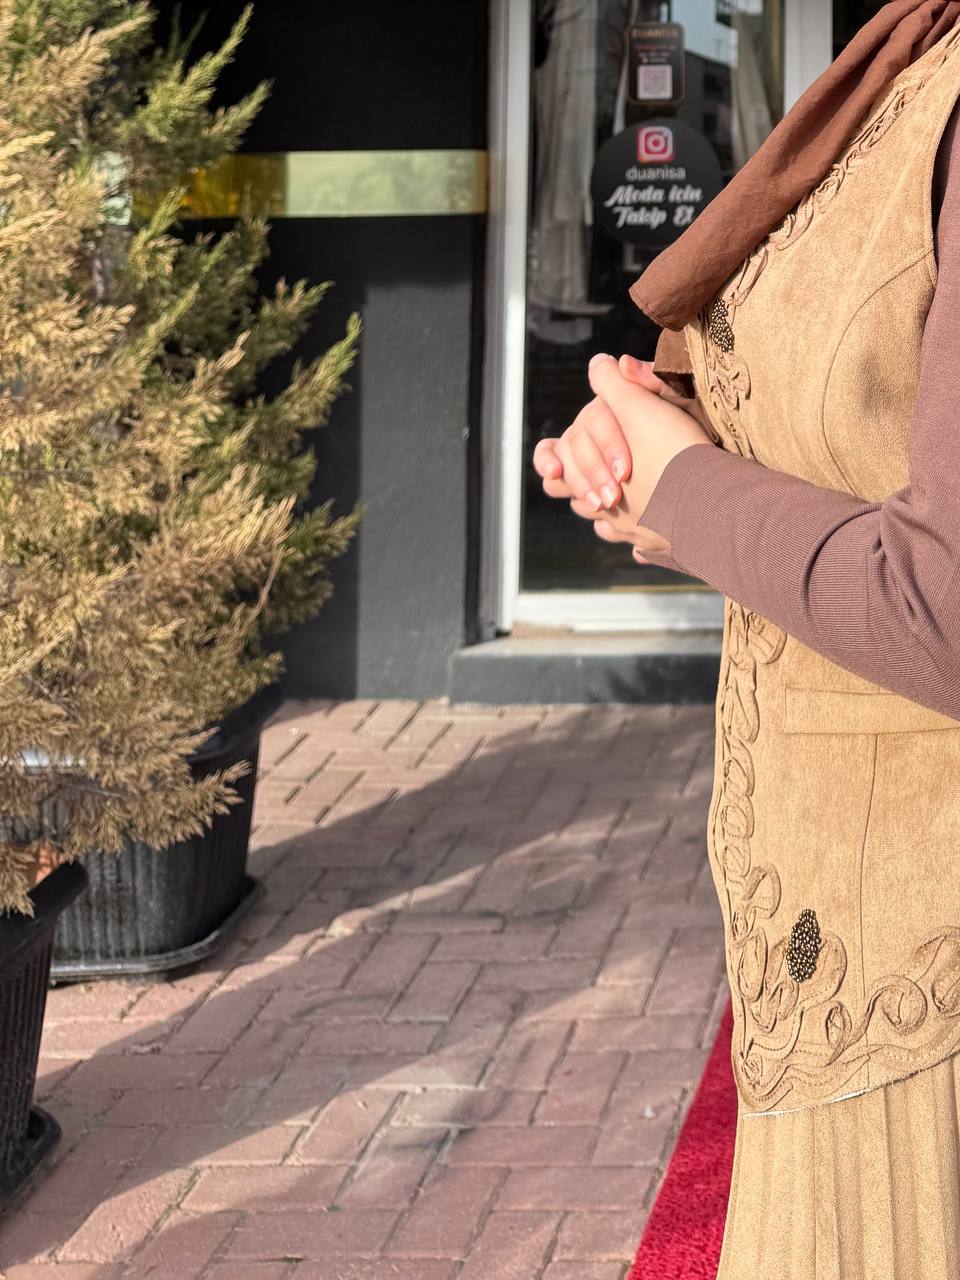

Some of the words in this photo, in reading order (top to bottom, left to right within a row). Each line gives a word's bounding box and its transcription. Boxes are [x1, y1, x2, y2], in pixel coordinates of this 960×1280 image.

[625, 166, 687, 181] duanisa
[604, 184, 665, 207] Moda
[612, 206, 667, 229] Takip
[673, 205, 695, 226] Et
